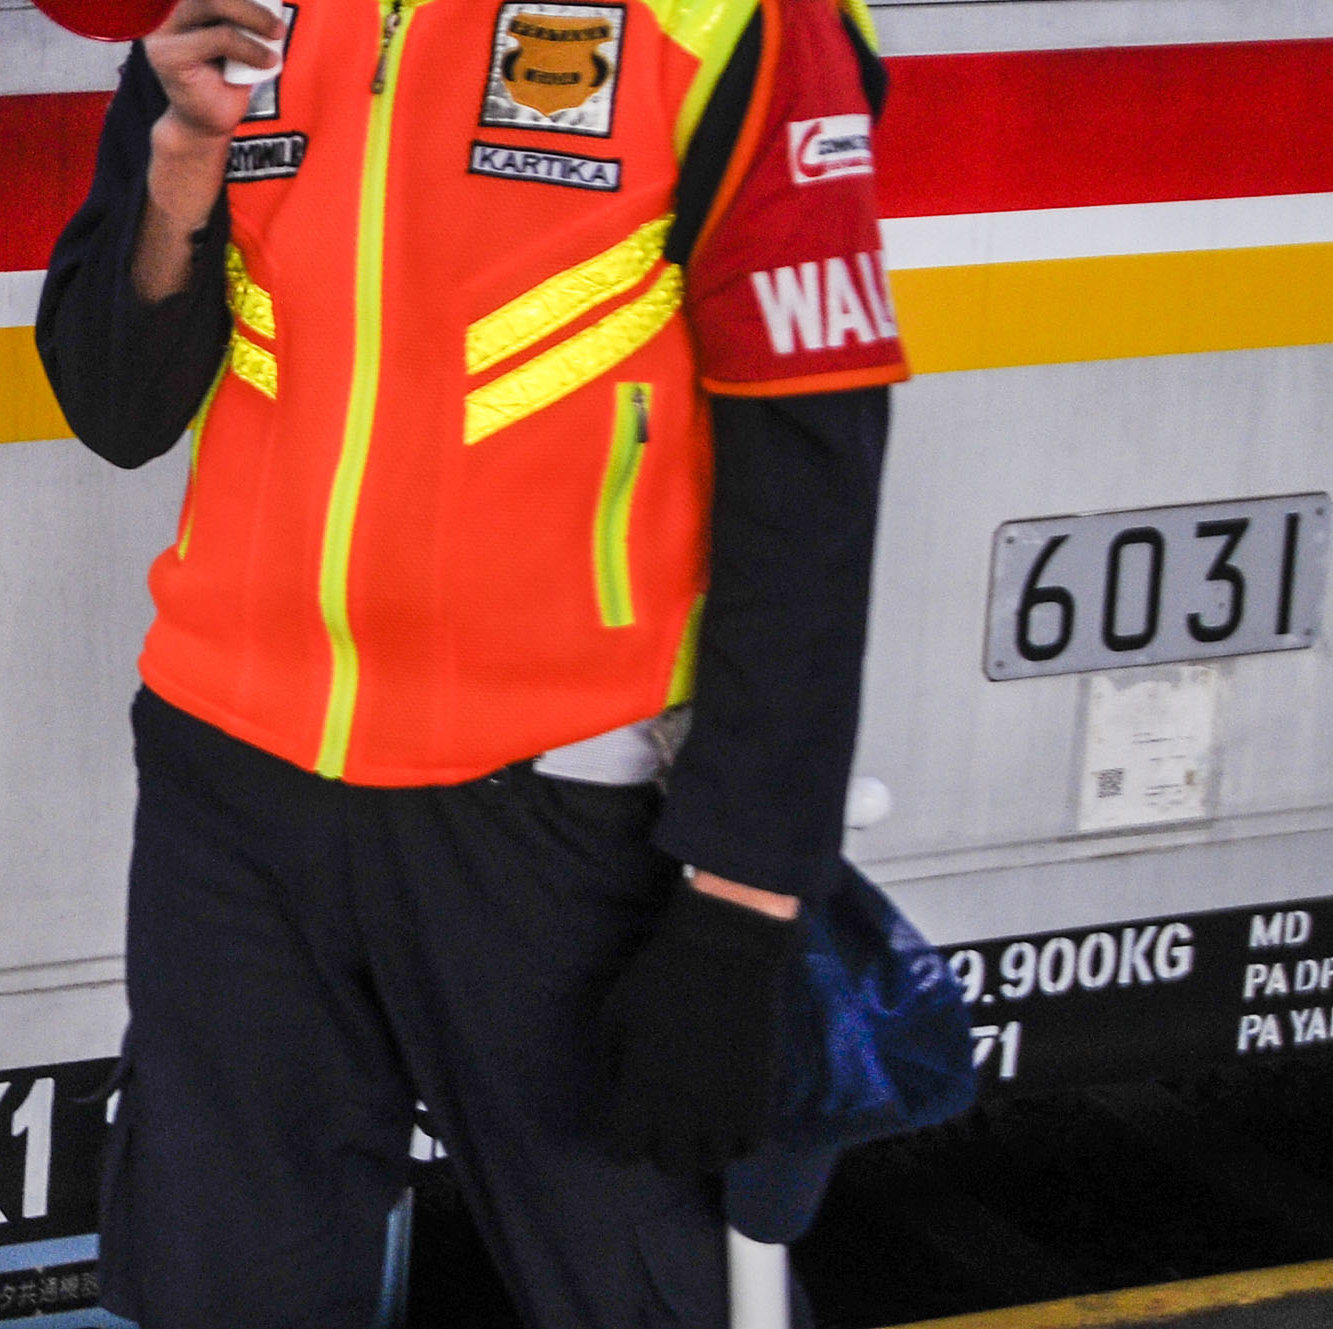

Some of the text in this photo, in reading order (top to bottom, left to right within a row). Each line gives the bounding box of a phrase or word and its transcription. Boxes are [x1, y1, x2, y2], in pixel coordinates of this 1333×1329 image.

[479, 146, 611, 185] KARTIKA
[1015, 511, 1303, 663] 6031
[1248, 910, 1311, 949] MD
[1242, 962, 1290, 1000] PA
[1236, 1005, 1333, 1054] PA YA
